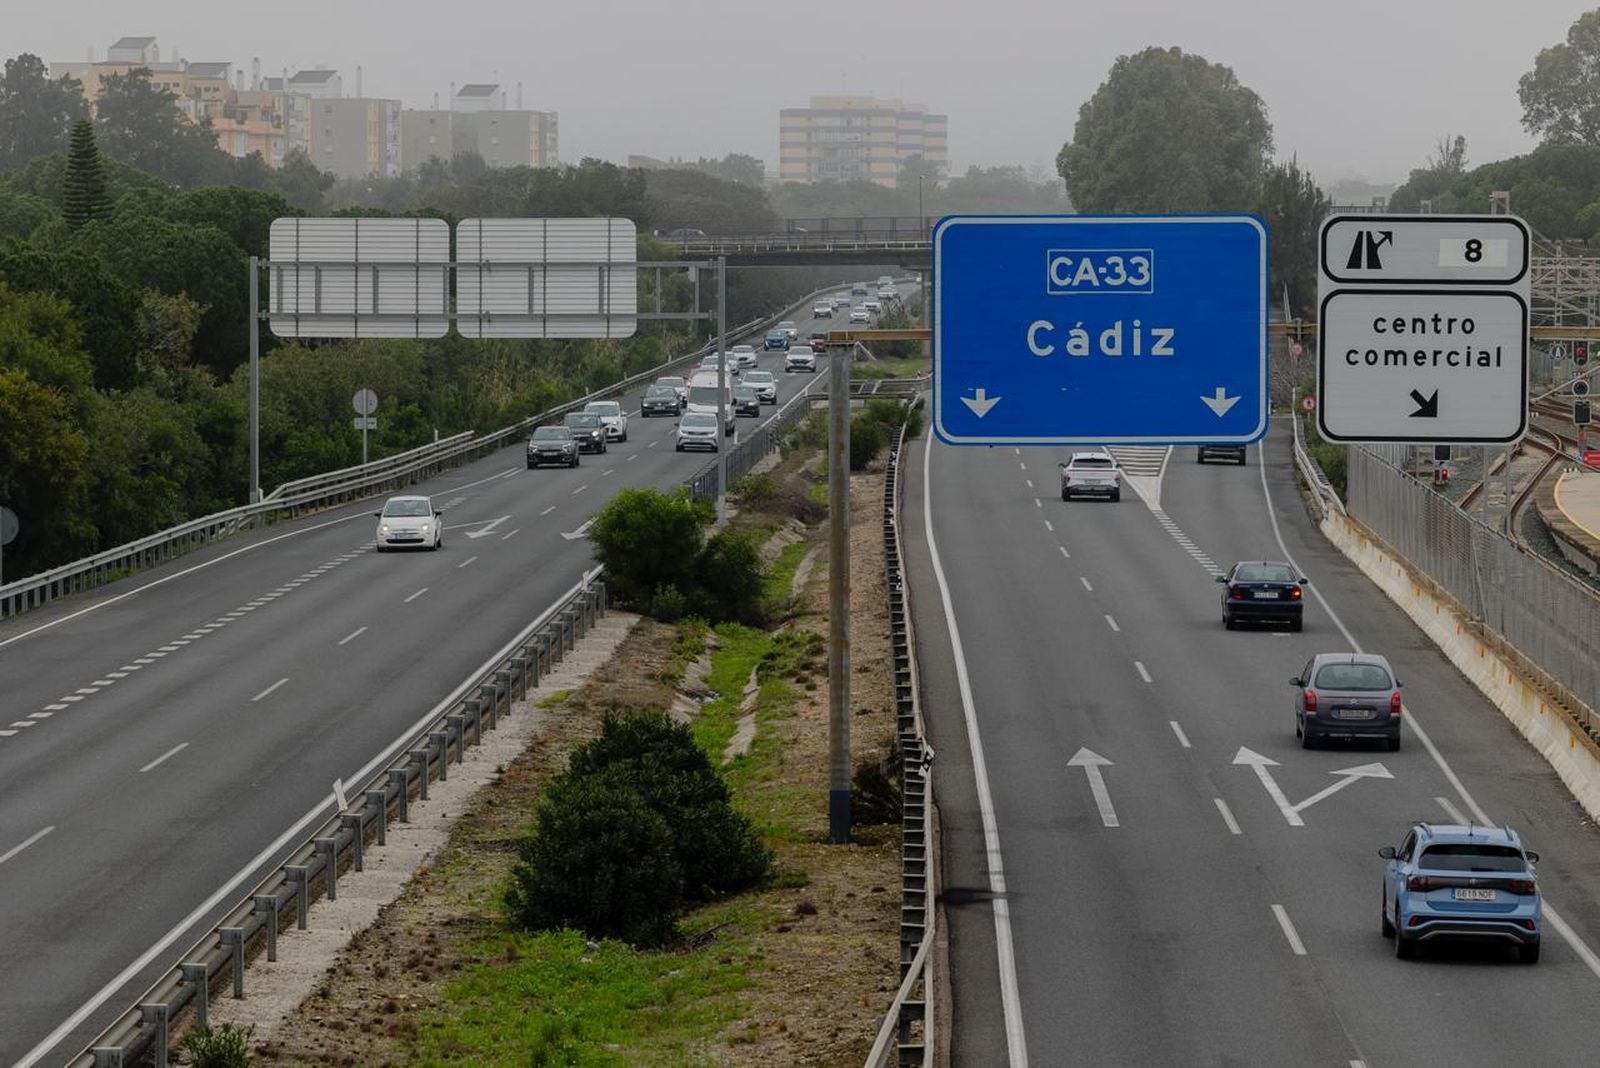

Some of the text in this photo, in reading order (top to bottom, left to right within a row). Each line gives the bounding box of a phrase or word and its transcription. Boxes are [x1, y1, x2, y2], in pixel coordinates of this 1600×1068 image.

[1464, 238, 1482, 263] 8
[1050, 256, 1151, 286] CA-33
[1373, 313, 1475, 335] centro
[1027, 319, 1175, 356] Cádiz
[1346, 345, 1502, 368] comercial
